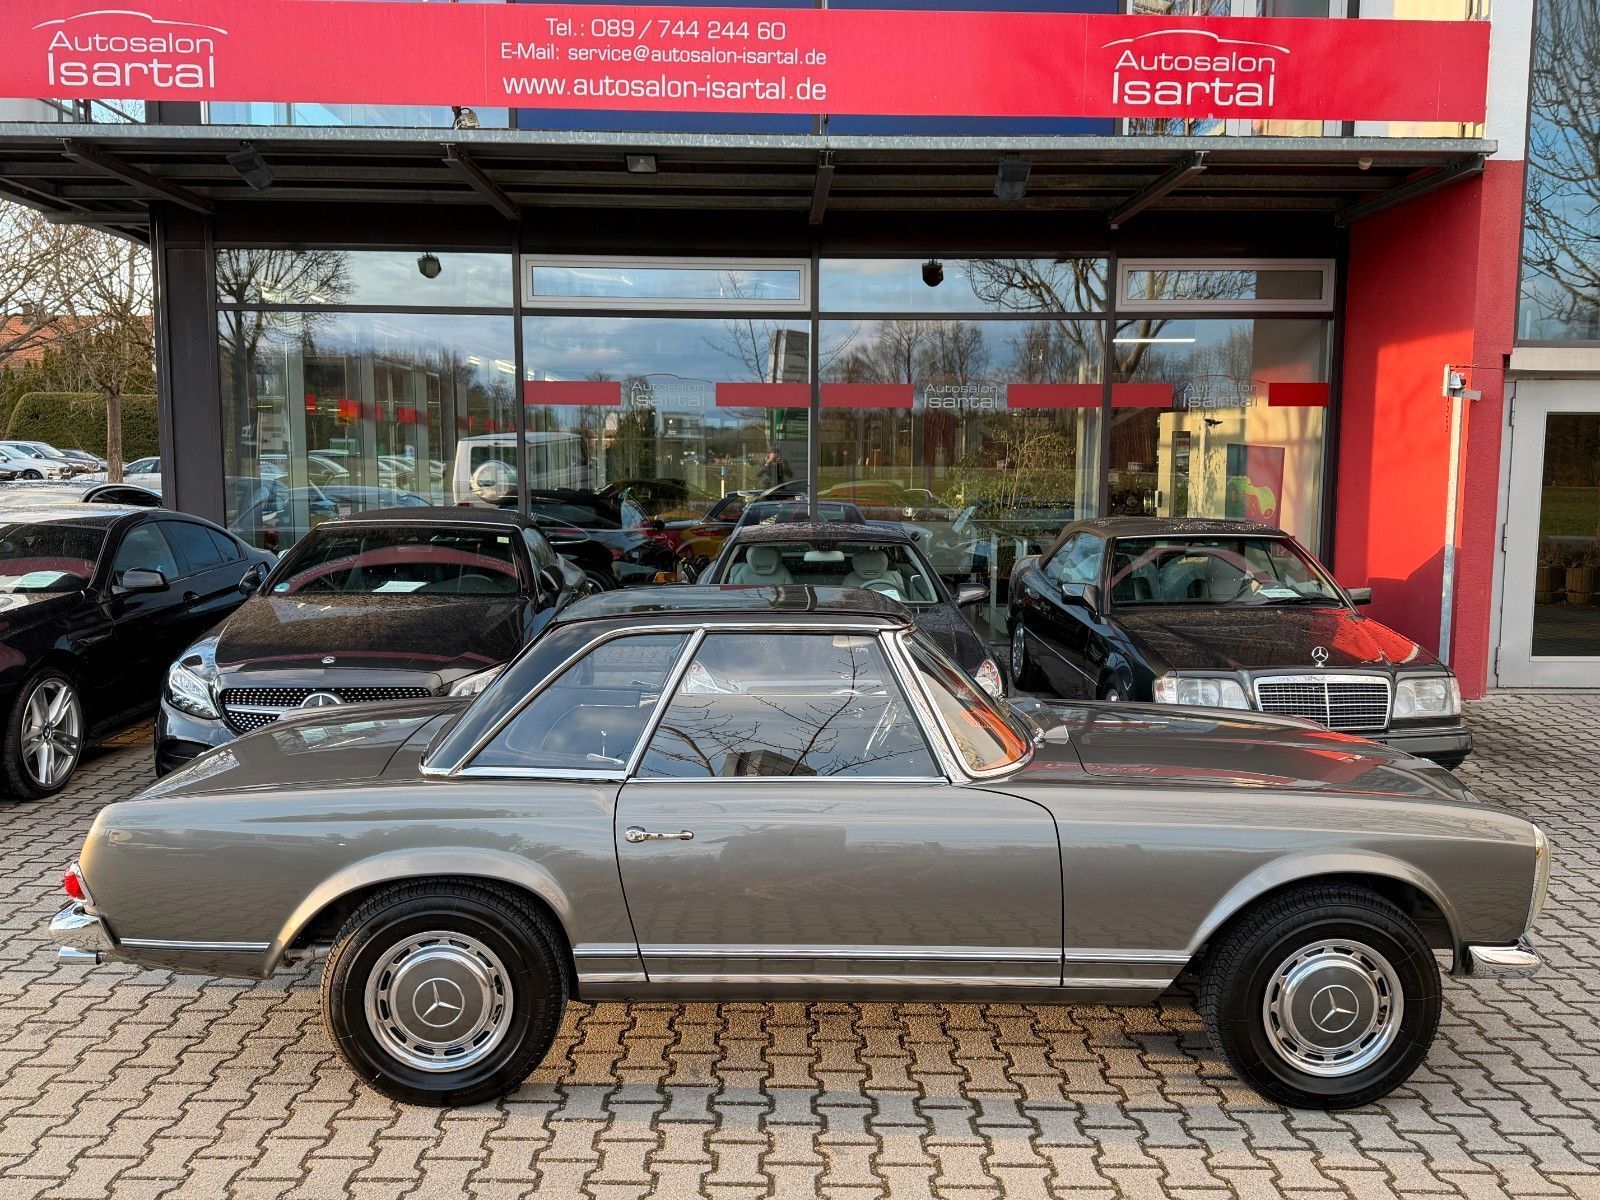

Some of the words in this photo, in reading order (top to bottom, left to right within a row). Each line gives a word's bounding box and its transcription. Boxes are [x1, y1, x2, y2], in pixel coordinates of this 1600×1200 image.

[545, 17, 585, 37] Tel.:
[591, 18, 635, 38] 089
[657, 20, 699, 39] 744
[707, 20, 750, 40] 244
[757, 21, 786, 41] 60
[48, 30, 214, 54] Autosalon
[501, 42, 560, 61] E-Mail:
[567, 44, 828, 65] service@autosalon-isartal.de
[47, 52, 215, 88] Isartal
[1114, 49, 1276, 73] Autosalon
[502, 73, 828, 101] www.autosalon-isartal.de
[1112, 71, 1275, 107] Isartal
[631, 380, 705, 392] Autosalon
[924, 383, 998, 394] Autosalon
[1183, 382, 1260, 393] Autosalon
[630, 390, 705, 407] Isartal
[924, 392, 999, 409] Isartal
[1182, 392, 1258, 408] Isartal
